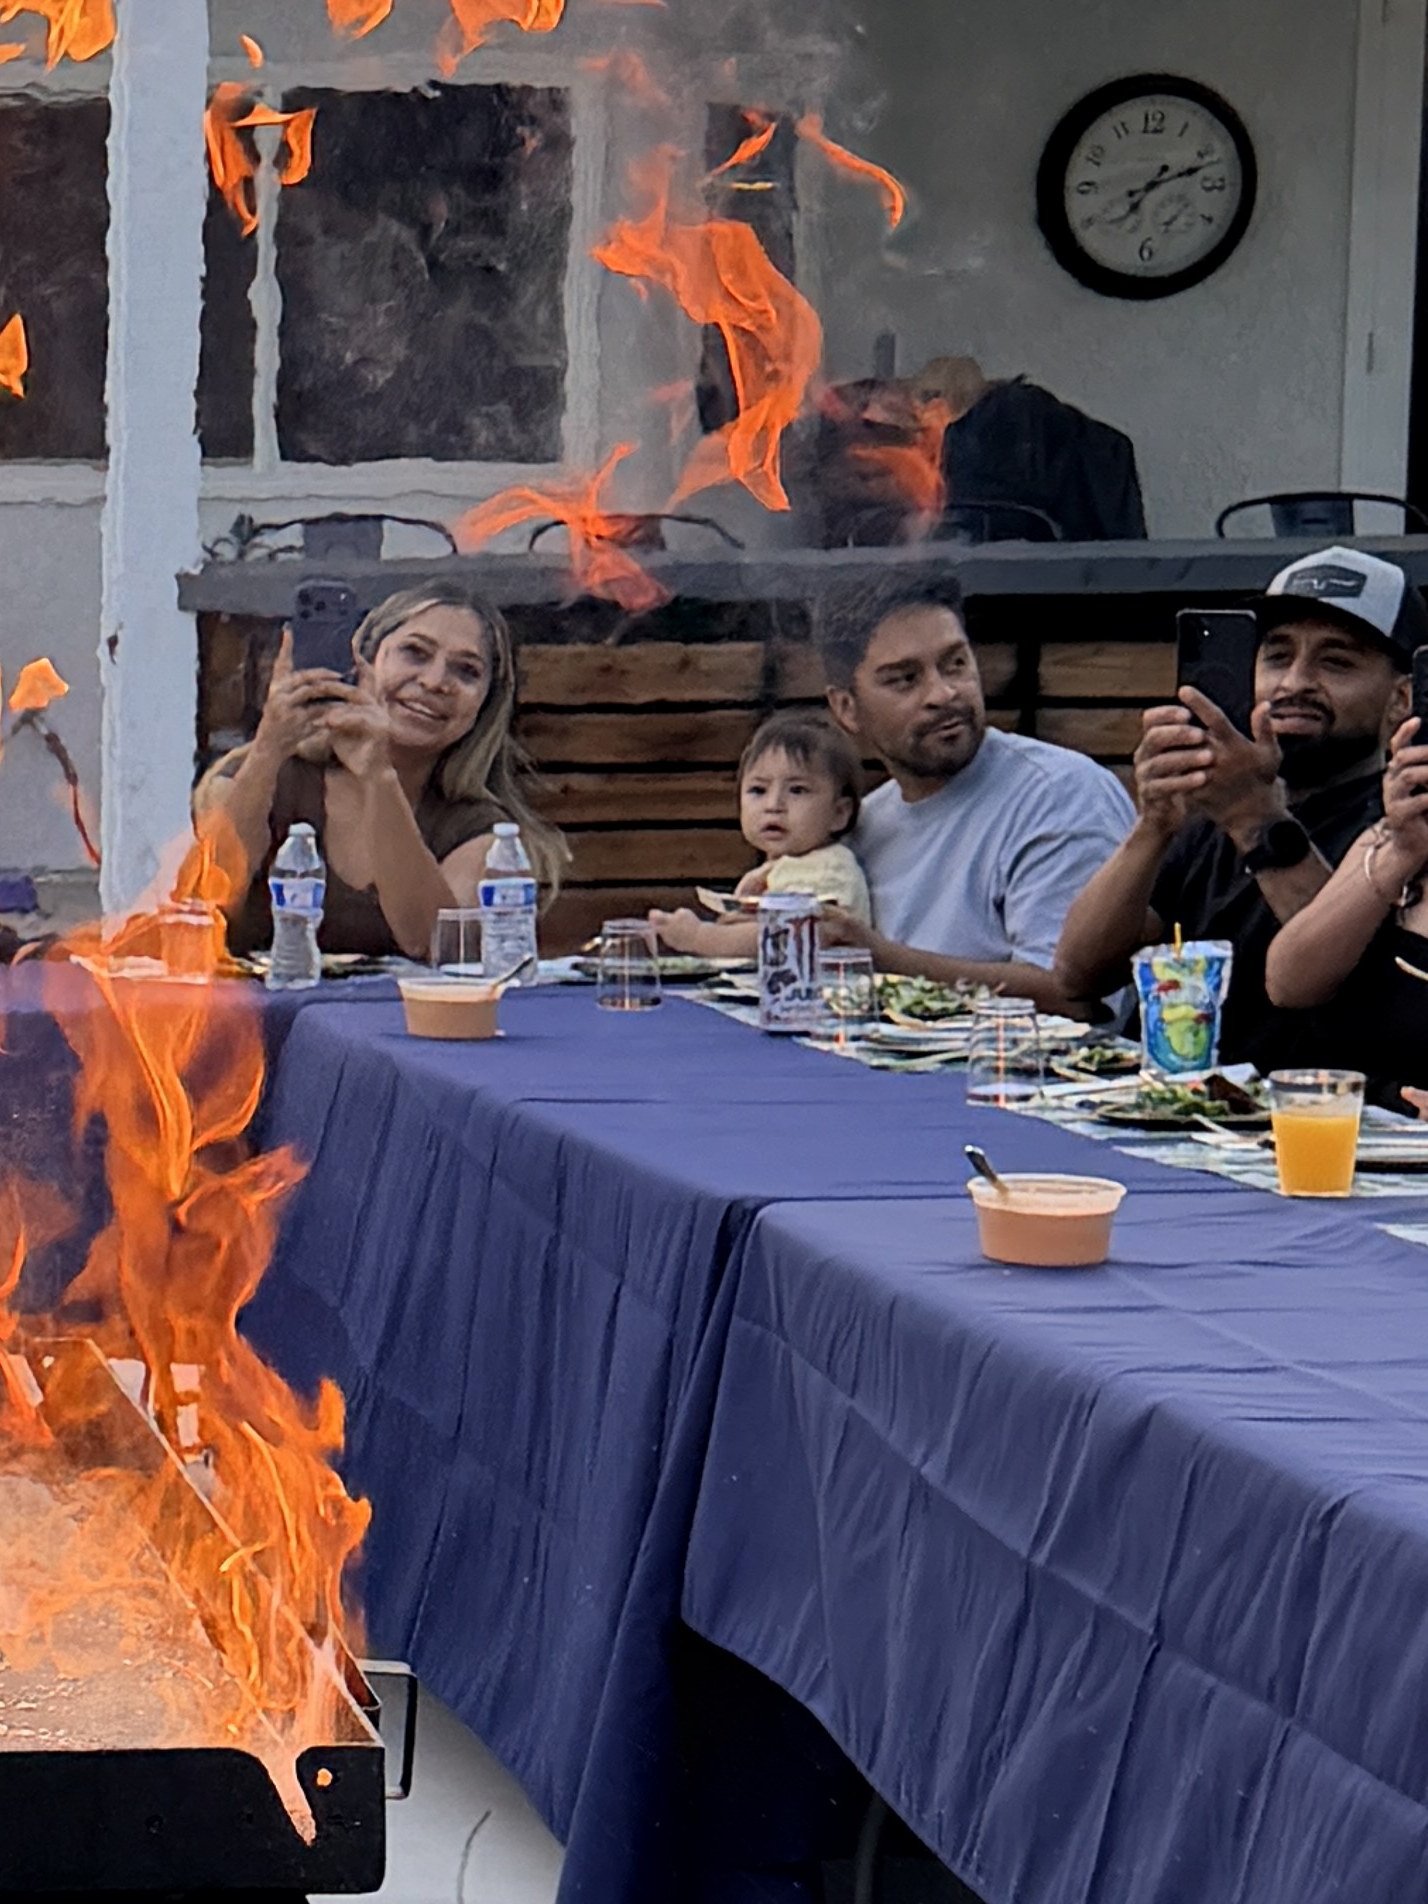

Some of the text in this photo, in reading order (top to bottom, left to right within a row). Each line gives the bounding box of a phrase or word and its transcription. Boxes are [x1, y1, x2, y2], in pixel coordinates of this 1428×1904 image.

[1112, 120, 1130, 140] 11
[1141, 109, 1166, 134] 12
[1177, 120, 1190, 138] 1
[1085, 145, 1105, 167] 10
[1075, 180, 1097, 195] 9
[1200, 175, 1226, 192] 3
[1138, 236, 1154, 262] 6
